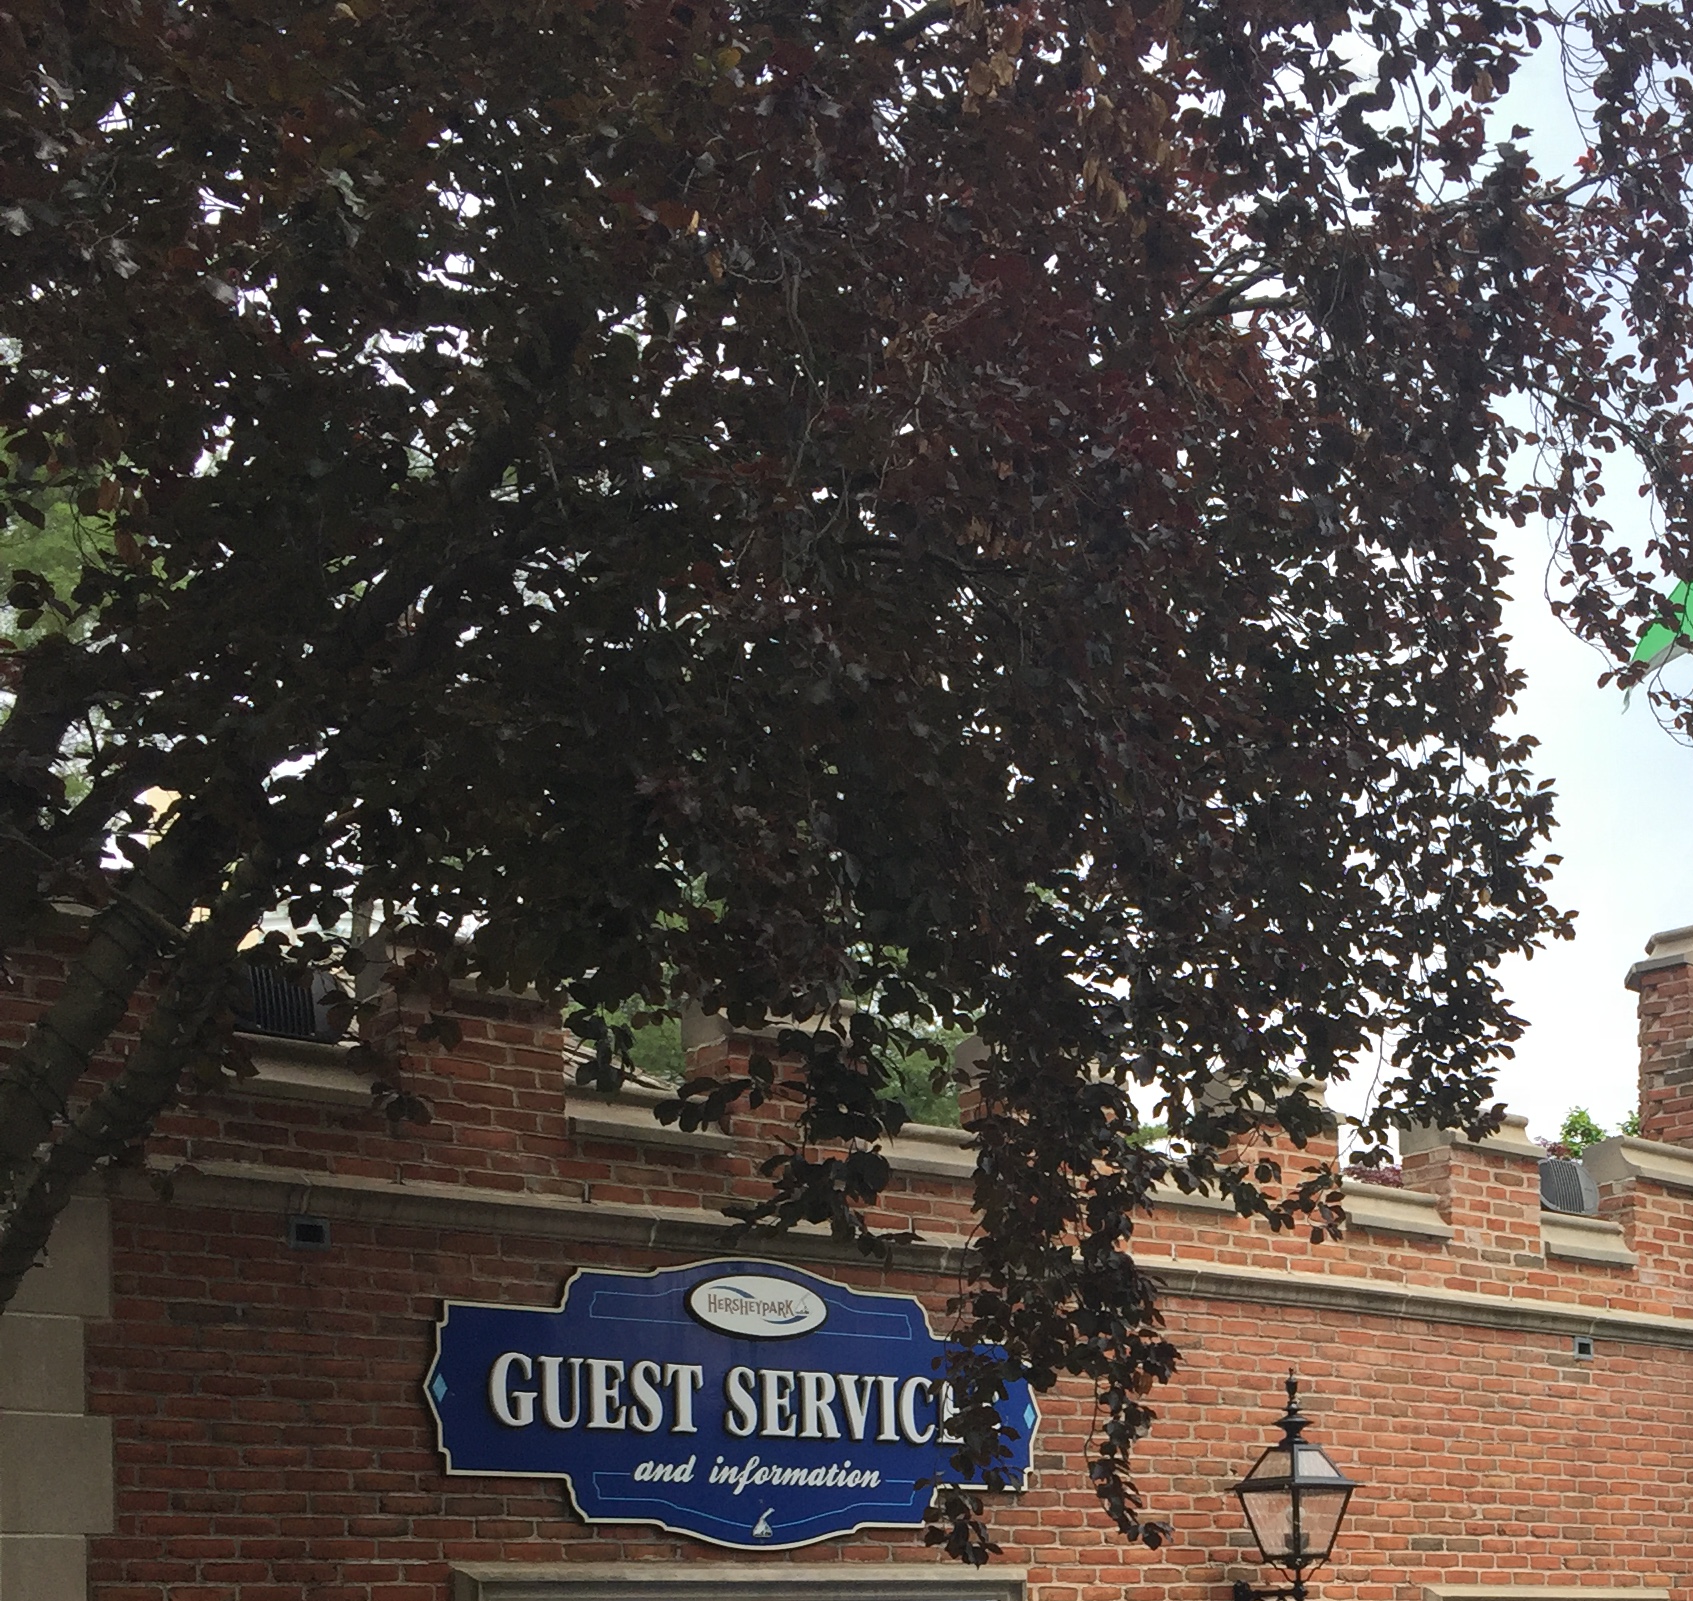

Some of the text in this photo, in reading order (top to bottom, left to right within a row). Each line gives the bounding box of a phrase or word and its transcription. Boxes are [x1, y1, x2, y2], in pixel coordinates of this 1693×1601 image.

[707, 1292, 795, 1318] HERSHEYPARK
[489, 1352, 966, 1444] GUEST SERVIC
[634, 1455, 881, 1494] and information
